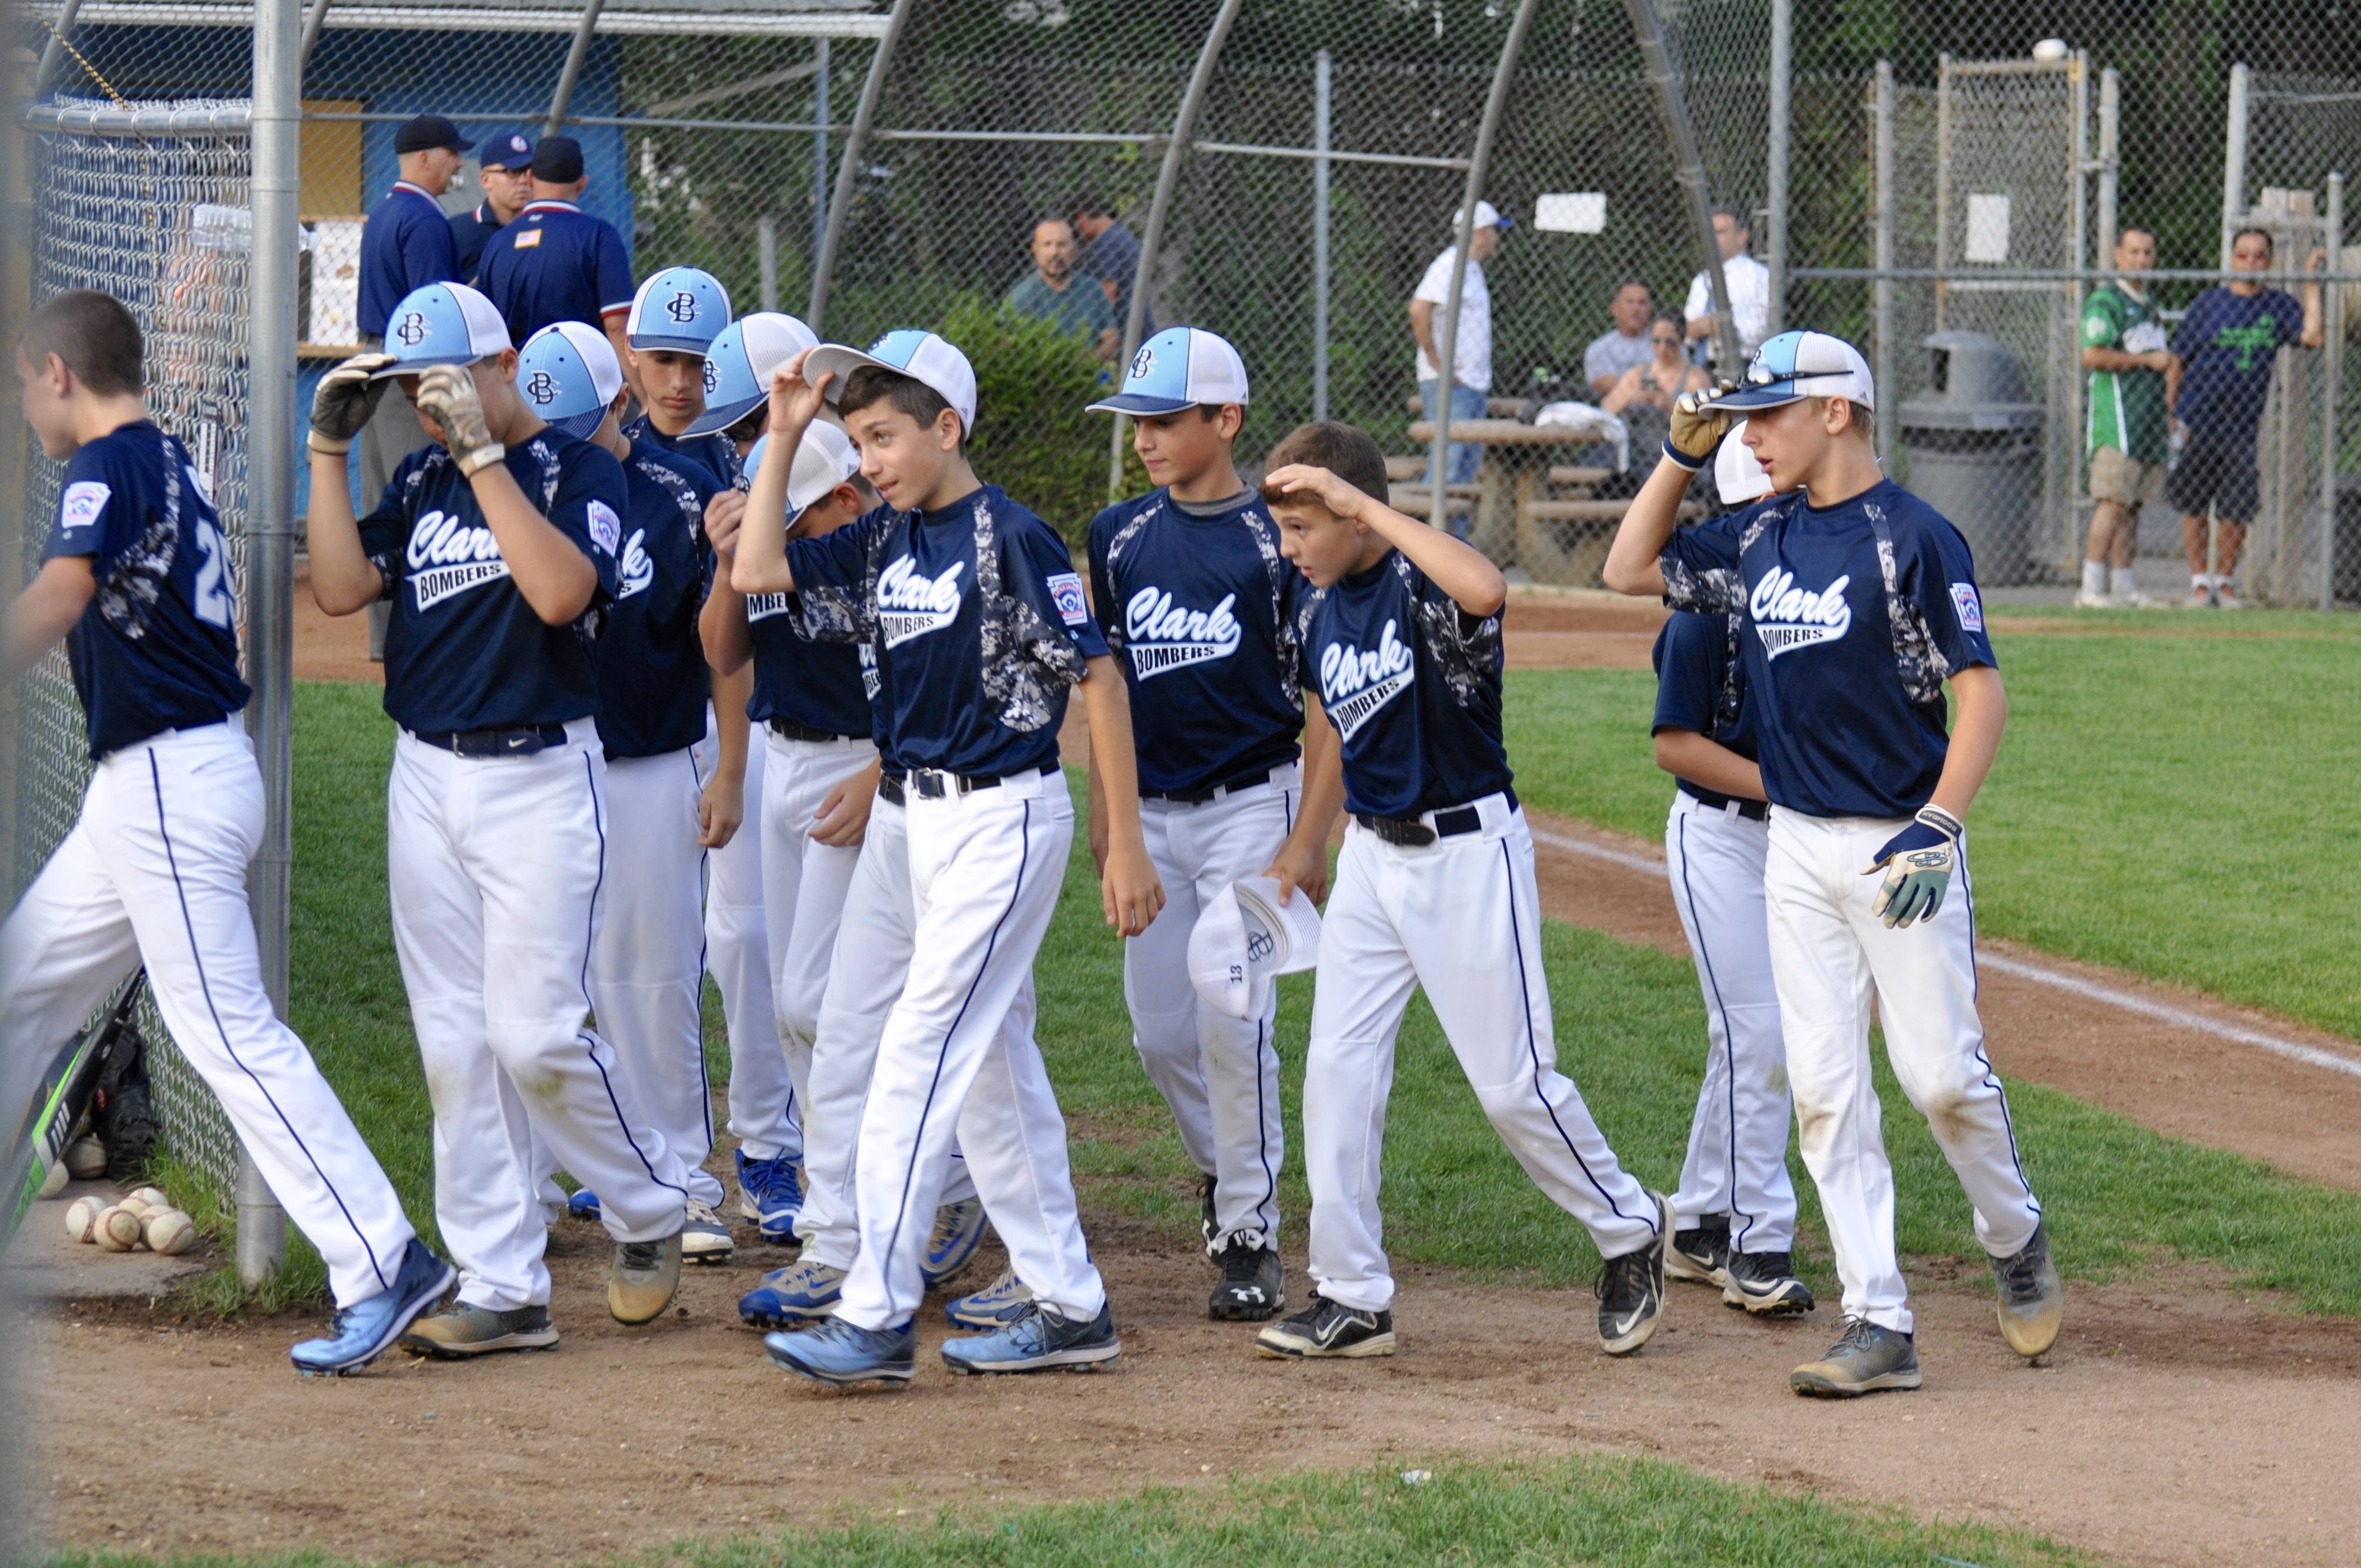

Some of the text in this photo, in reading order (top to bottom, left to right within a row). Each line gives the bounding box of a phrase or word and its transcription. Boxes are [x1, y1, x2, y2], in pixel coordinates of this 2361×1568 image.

[420, 564, 502, 603] BOMBERS
[877, 553, 965, 613] Clark
[1750, 565, 1851, 626] Clark
[883, 616, 934, 642] BOMBERS
[1126, 586, 1241, 642] Clark
[1763, 628, 1823, 653] BOMBERS
[1136, 646, 1215, 675] BOMBERS
[1321, 619, 1413, 704] Clark
[1336, 678, 1400, 734] BOMBERS
